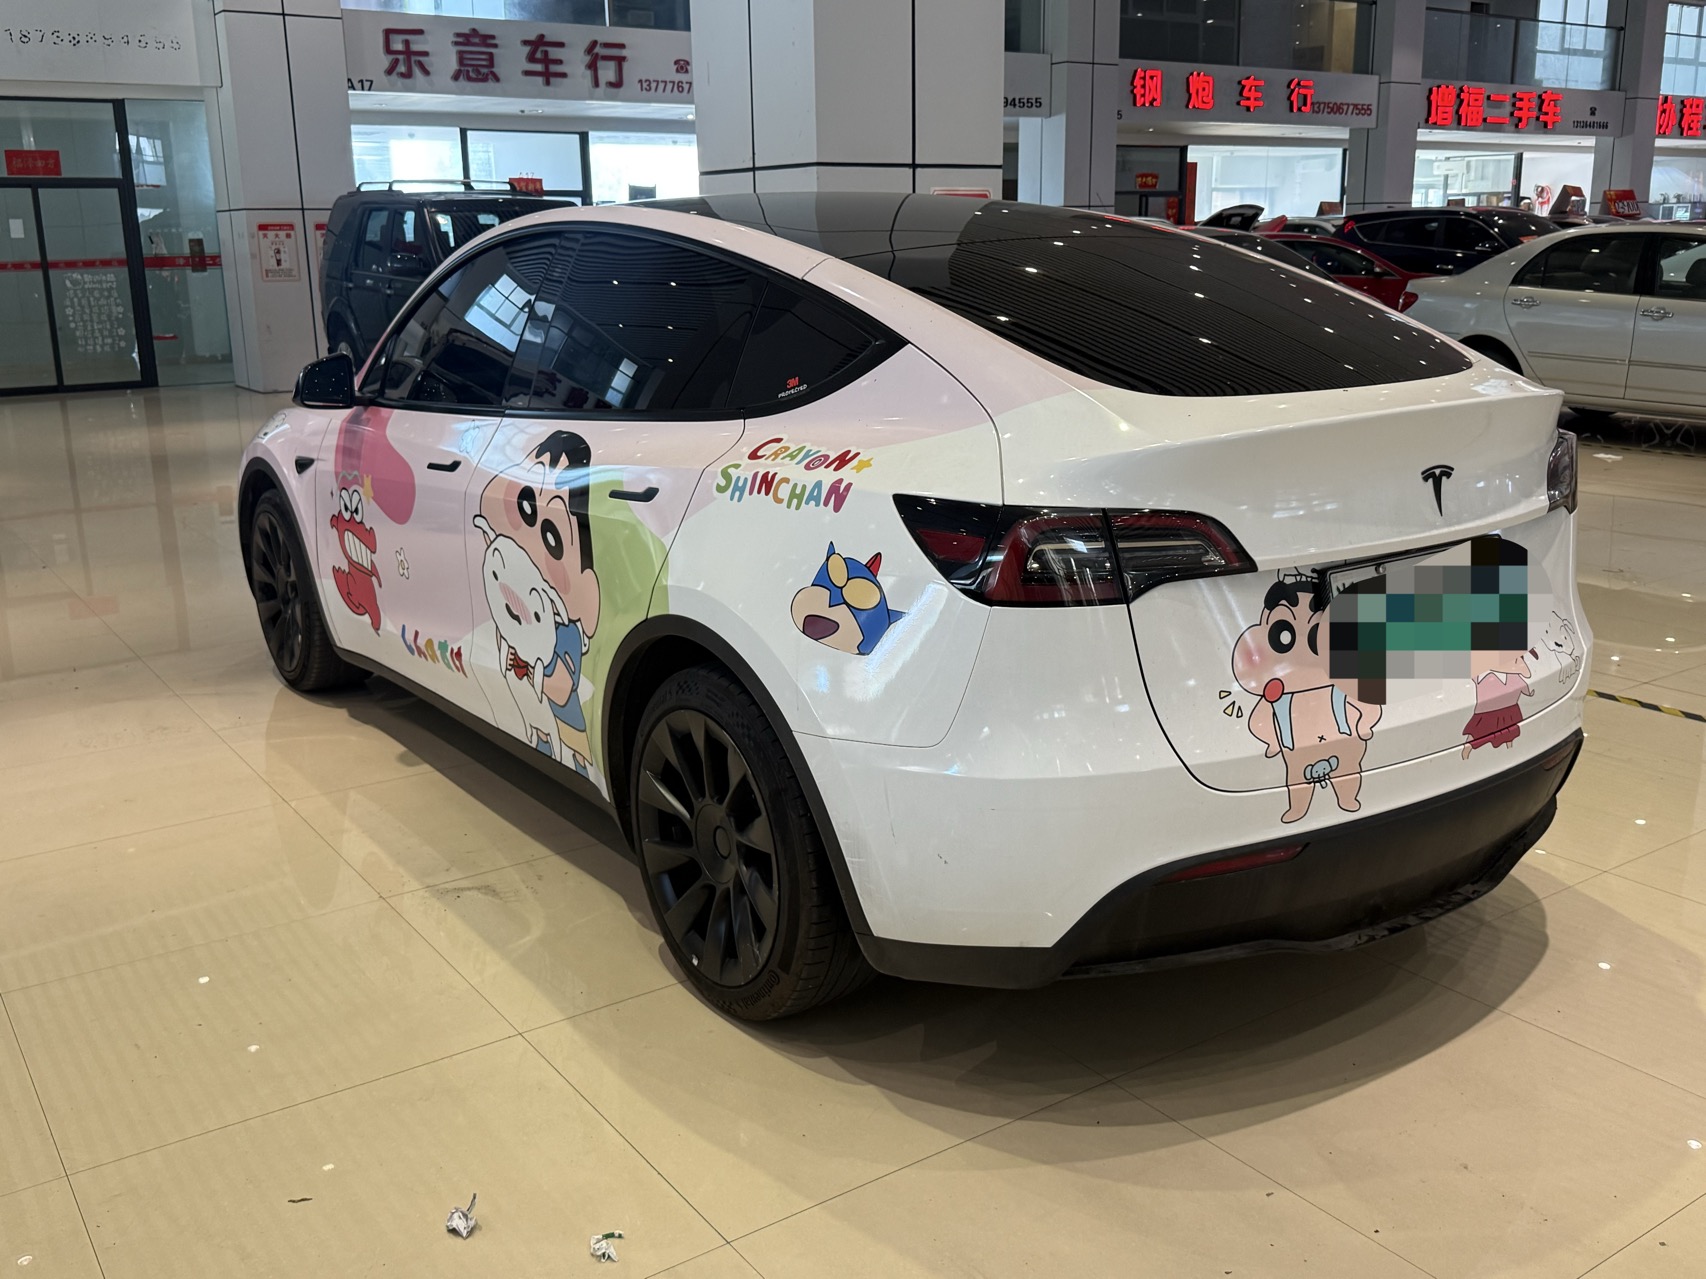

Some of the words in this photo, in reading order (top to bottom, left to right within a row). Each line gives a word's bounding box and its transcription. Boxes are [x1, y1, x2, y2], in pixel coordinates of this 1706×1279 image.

[382, 28, 628, 89] 乐意车行
[347, 77, 374, 91] A17
[637, 78, 693, 95] 1377767
[1132, 67, 1315, 113] 钢炮车行
[1428, 84, 1563, 129] 增福二手车
[777, 383, 808, 399] PROTECTED
[786, 376, 800, 389] 3M
[747, 437, 861, 472] CRAYON
[715, 463, 854, 514] SHINCHAN
